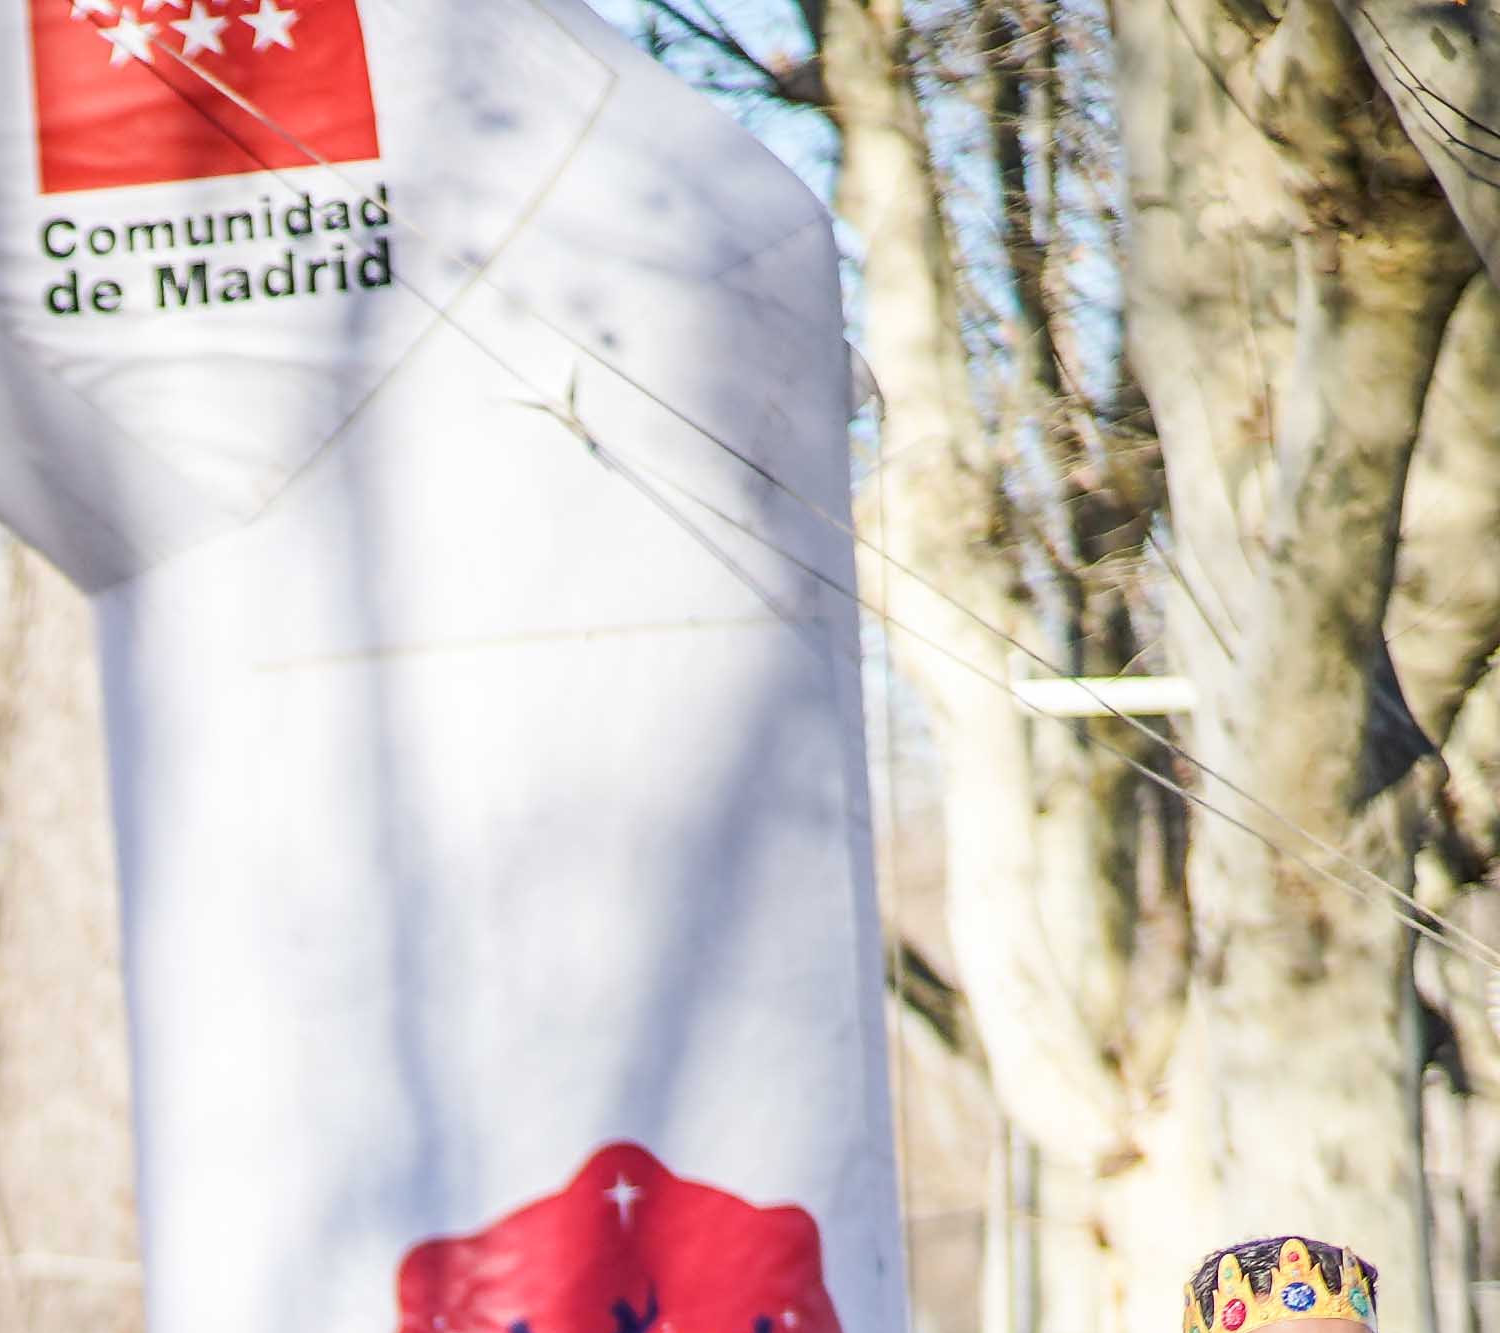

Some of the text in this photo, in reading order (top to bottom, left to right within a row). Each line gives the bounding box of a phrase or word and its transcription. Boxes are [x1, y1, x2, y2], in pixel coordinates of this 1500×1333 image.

[43, 183, 390, 258] Comunidad
[47, 236, 393, 315] de Madrid
